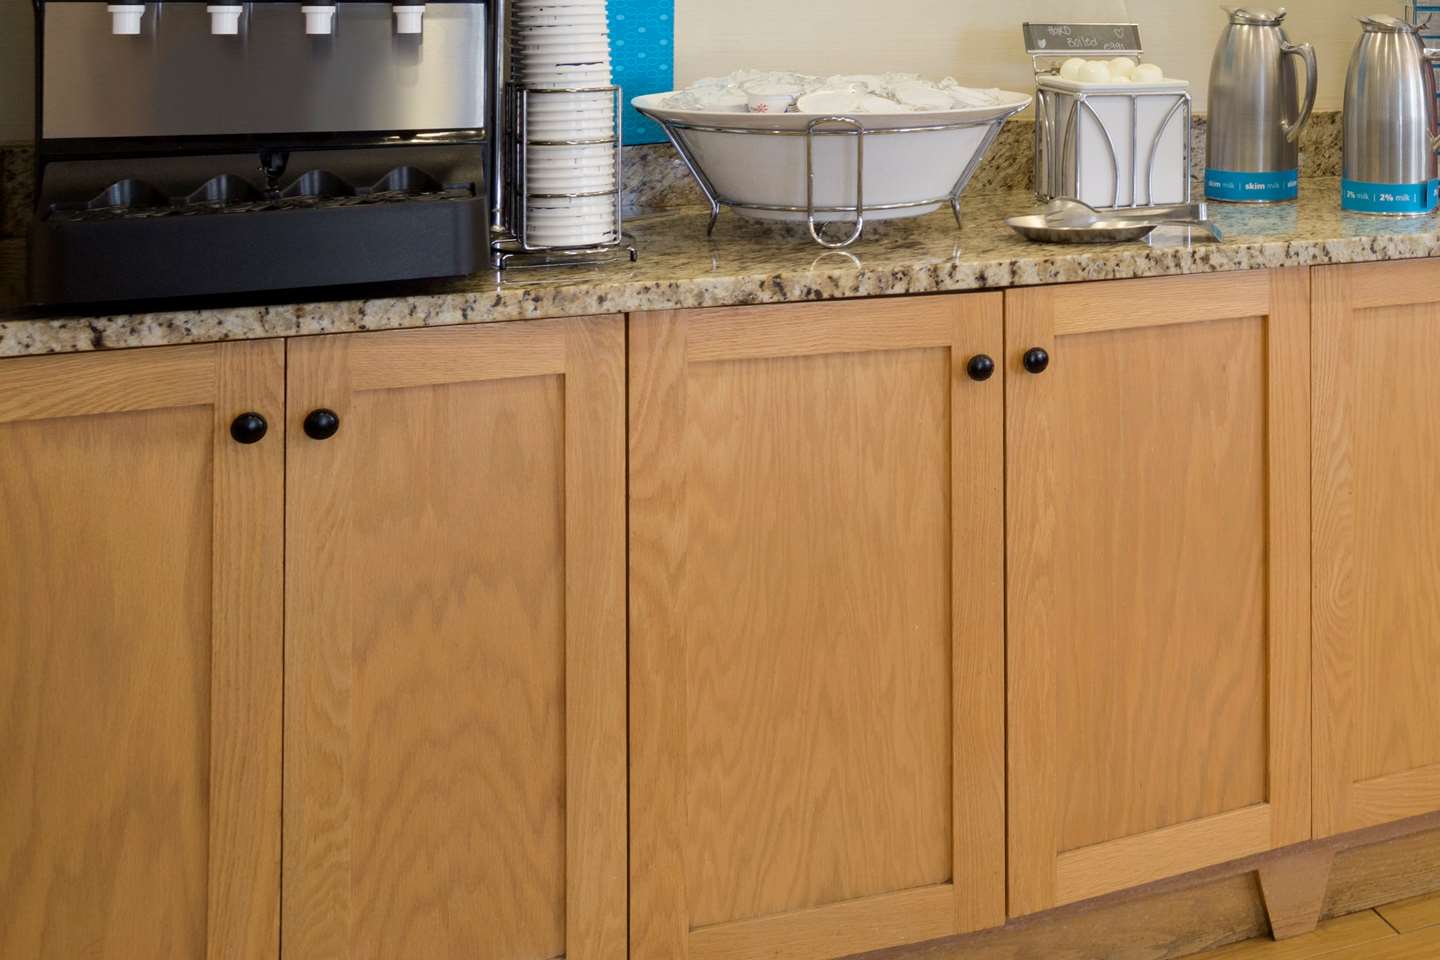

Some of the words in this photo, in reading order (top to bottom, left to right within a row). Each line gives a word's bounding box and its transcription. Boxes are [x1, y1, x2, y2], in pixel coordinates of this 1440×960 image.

[1245, 182, 1265, 190] skim
[1379, 193, 1394, 202] 2%
[1395, 193, 1410, 201] milk
